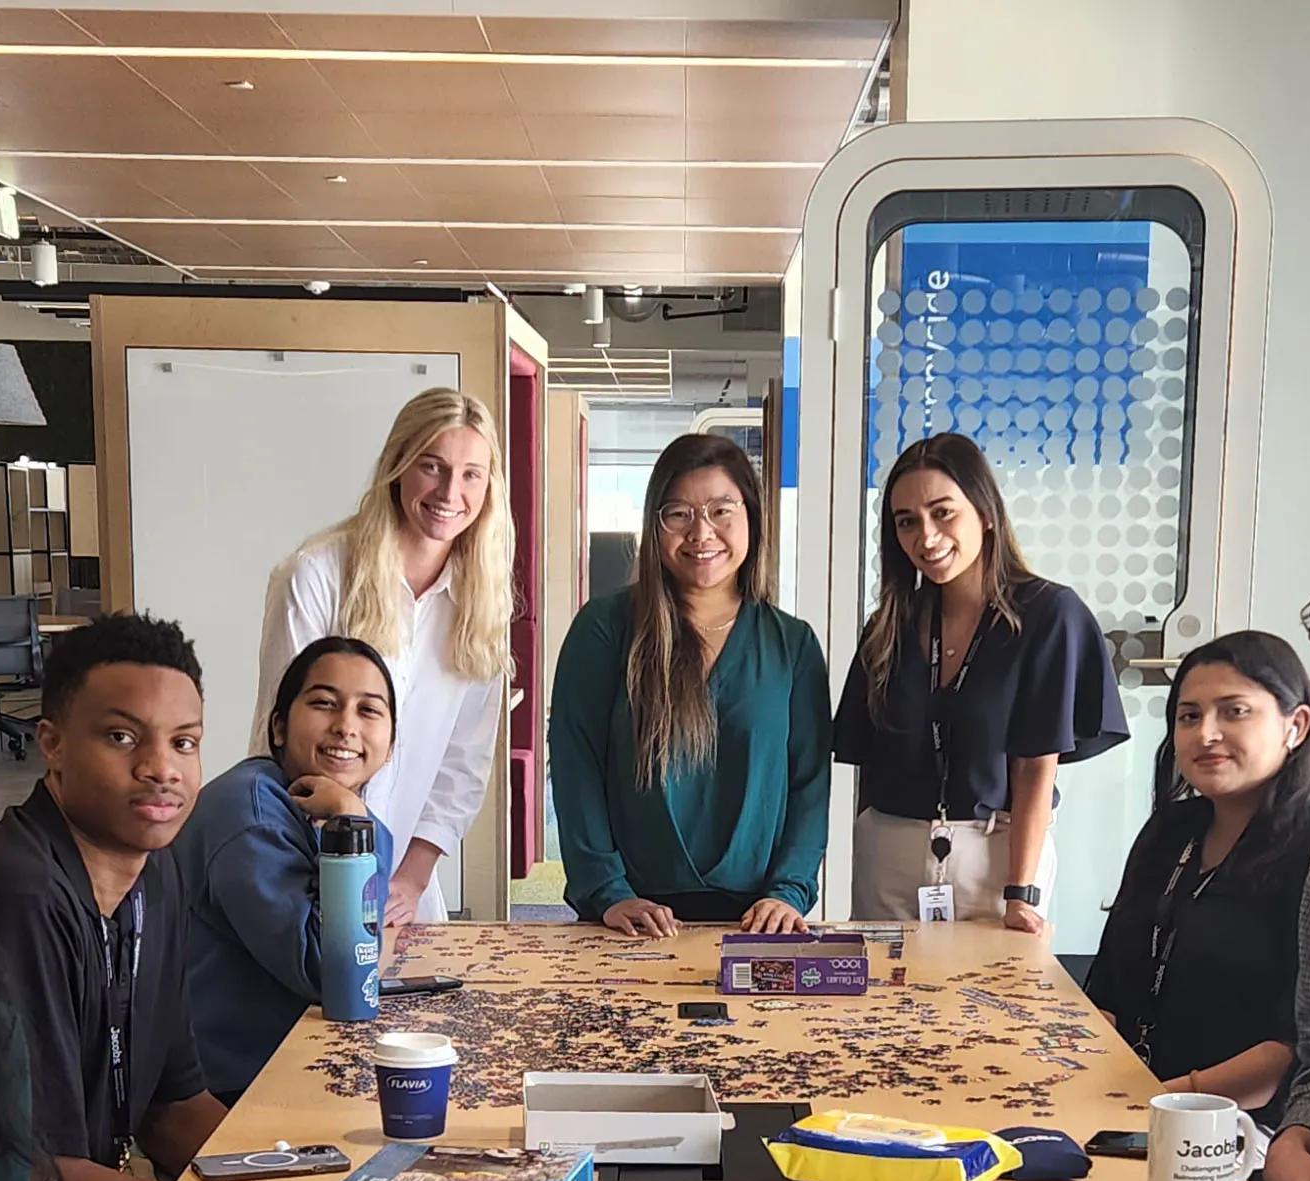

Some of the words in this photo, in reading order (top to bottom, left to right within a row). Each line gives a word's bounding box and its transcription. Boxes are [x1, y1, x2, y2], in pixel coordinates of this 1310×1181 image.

[110, 1025, 122, 1064] Jacobs
[390, 1079, 427, 1089] FLAVIA
[1176, 1138, 1236, 1158] Jacobs
